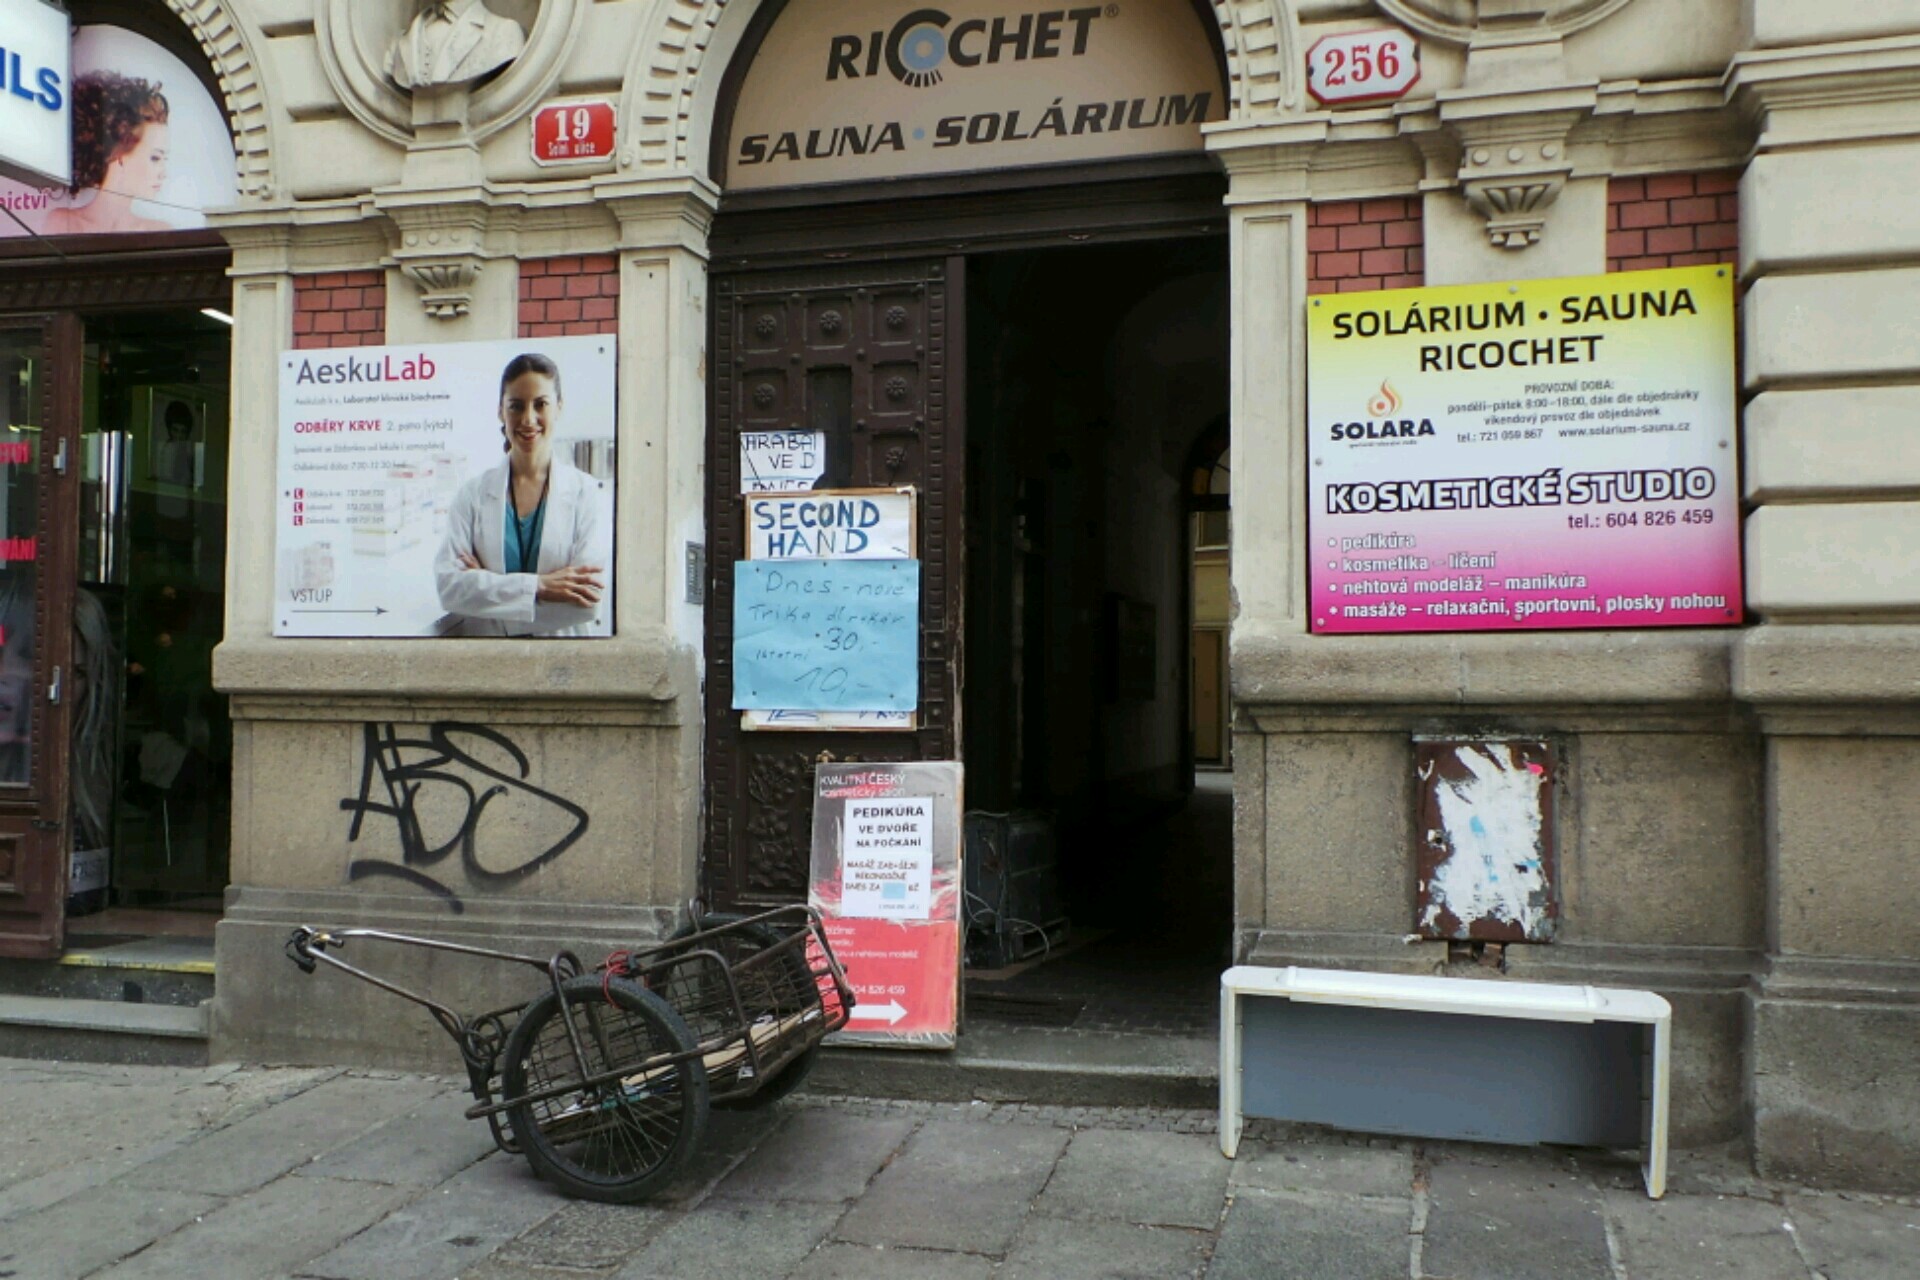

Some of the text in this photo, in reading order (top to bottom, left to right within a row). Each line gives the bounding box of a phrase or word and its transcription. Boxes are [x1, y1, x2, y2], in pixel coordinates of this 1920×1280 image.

[1324, 41, 1400, 87] 256
[555, 108, 590, 141] 19
[738, 92, 1212, 165] SAUNA SOLÁRIUM
[1333, 288, 1697, 339] SOLÁRIUM SAUNA
[1420, 335, 1604, 372] RICOCHET
[296, 353, 435, 385] AeskuLab
[1617, 392, 1633, 403] dle
[348, 419, 381, 432] KRVE
[1578, 409, 1594, 420] dle
[1331, 418, 1435, 441] SOLARA
[1327, 467, 1715, 514] KOSMETICKÉ STUDIO
[754, 500, 880, 530] SECOND
[1568, 508, 1714, 529] tel.: 604 826 459
[768, 529, 869, 557] HAND
[1342, 531, 1417, 553] pedikúra
[1342, 551, 1497, 573] kosmetika líčení
[766, 570, 832, 594] Dnes
[1343, 571, 1588, 596] nehtová modeláž manikúra
[290, 588, 333, 604] VSTUP
[1343, 599, 1407, 618] masáže
[1605, 593, 1665, 614] plosky
[1671, 592, 1727, 610] nohou
[868, 770, 906, 785] ČESKÝ
[859, 822, 918, 834] VE DVOŘE
[856, 839, 870, 848] NA
